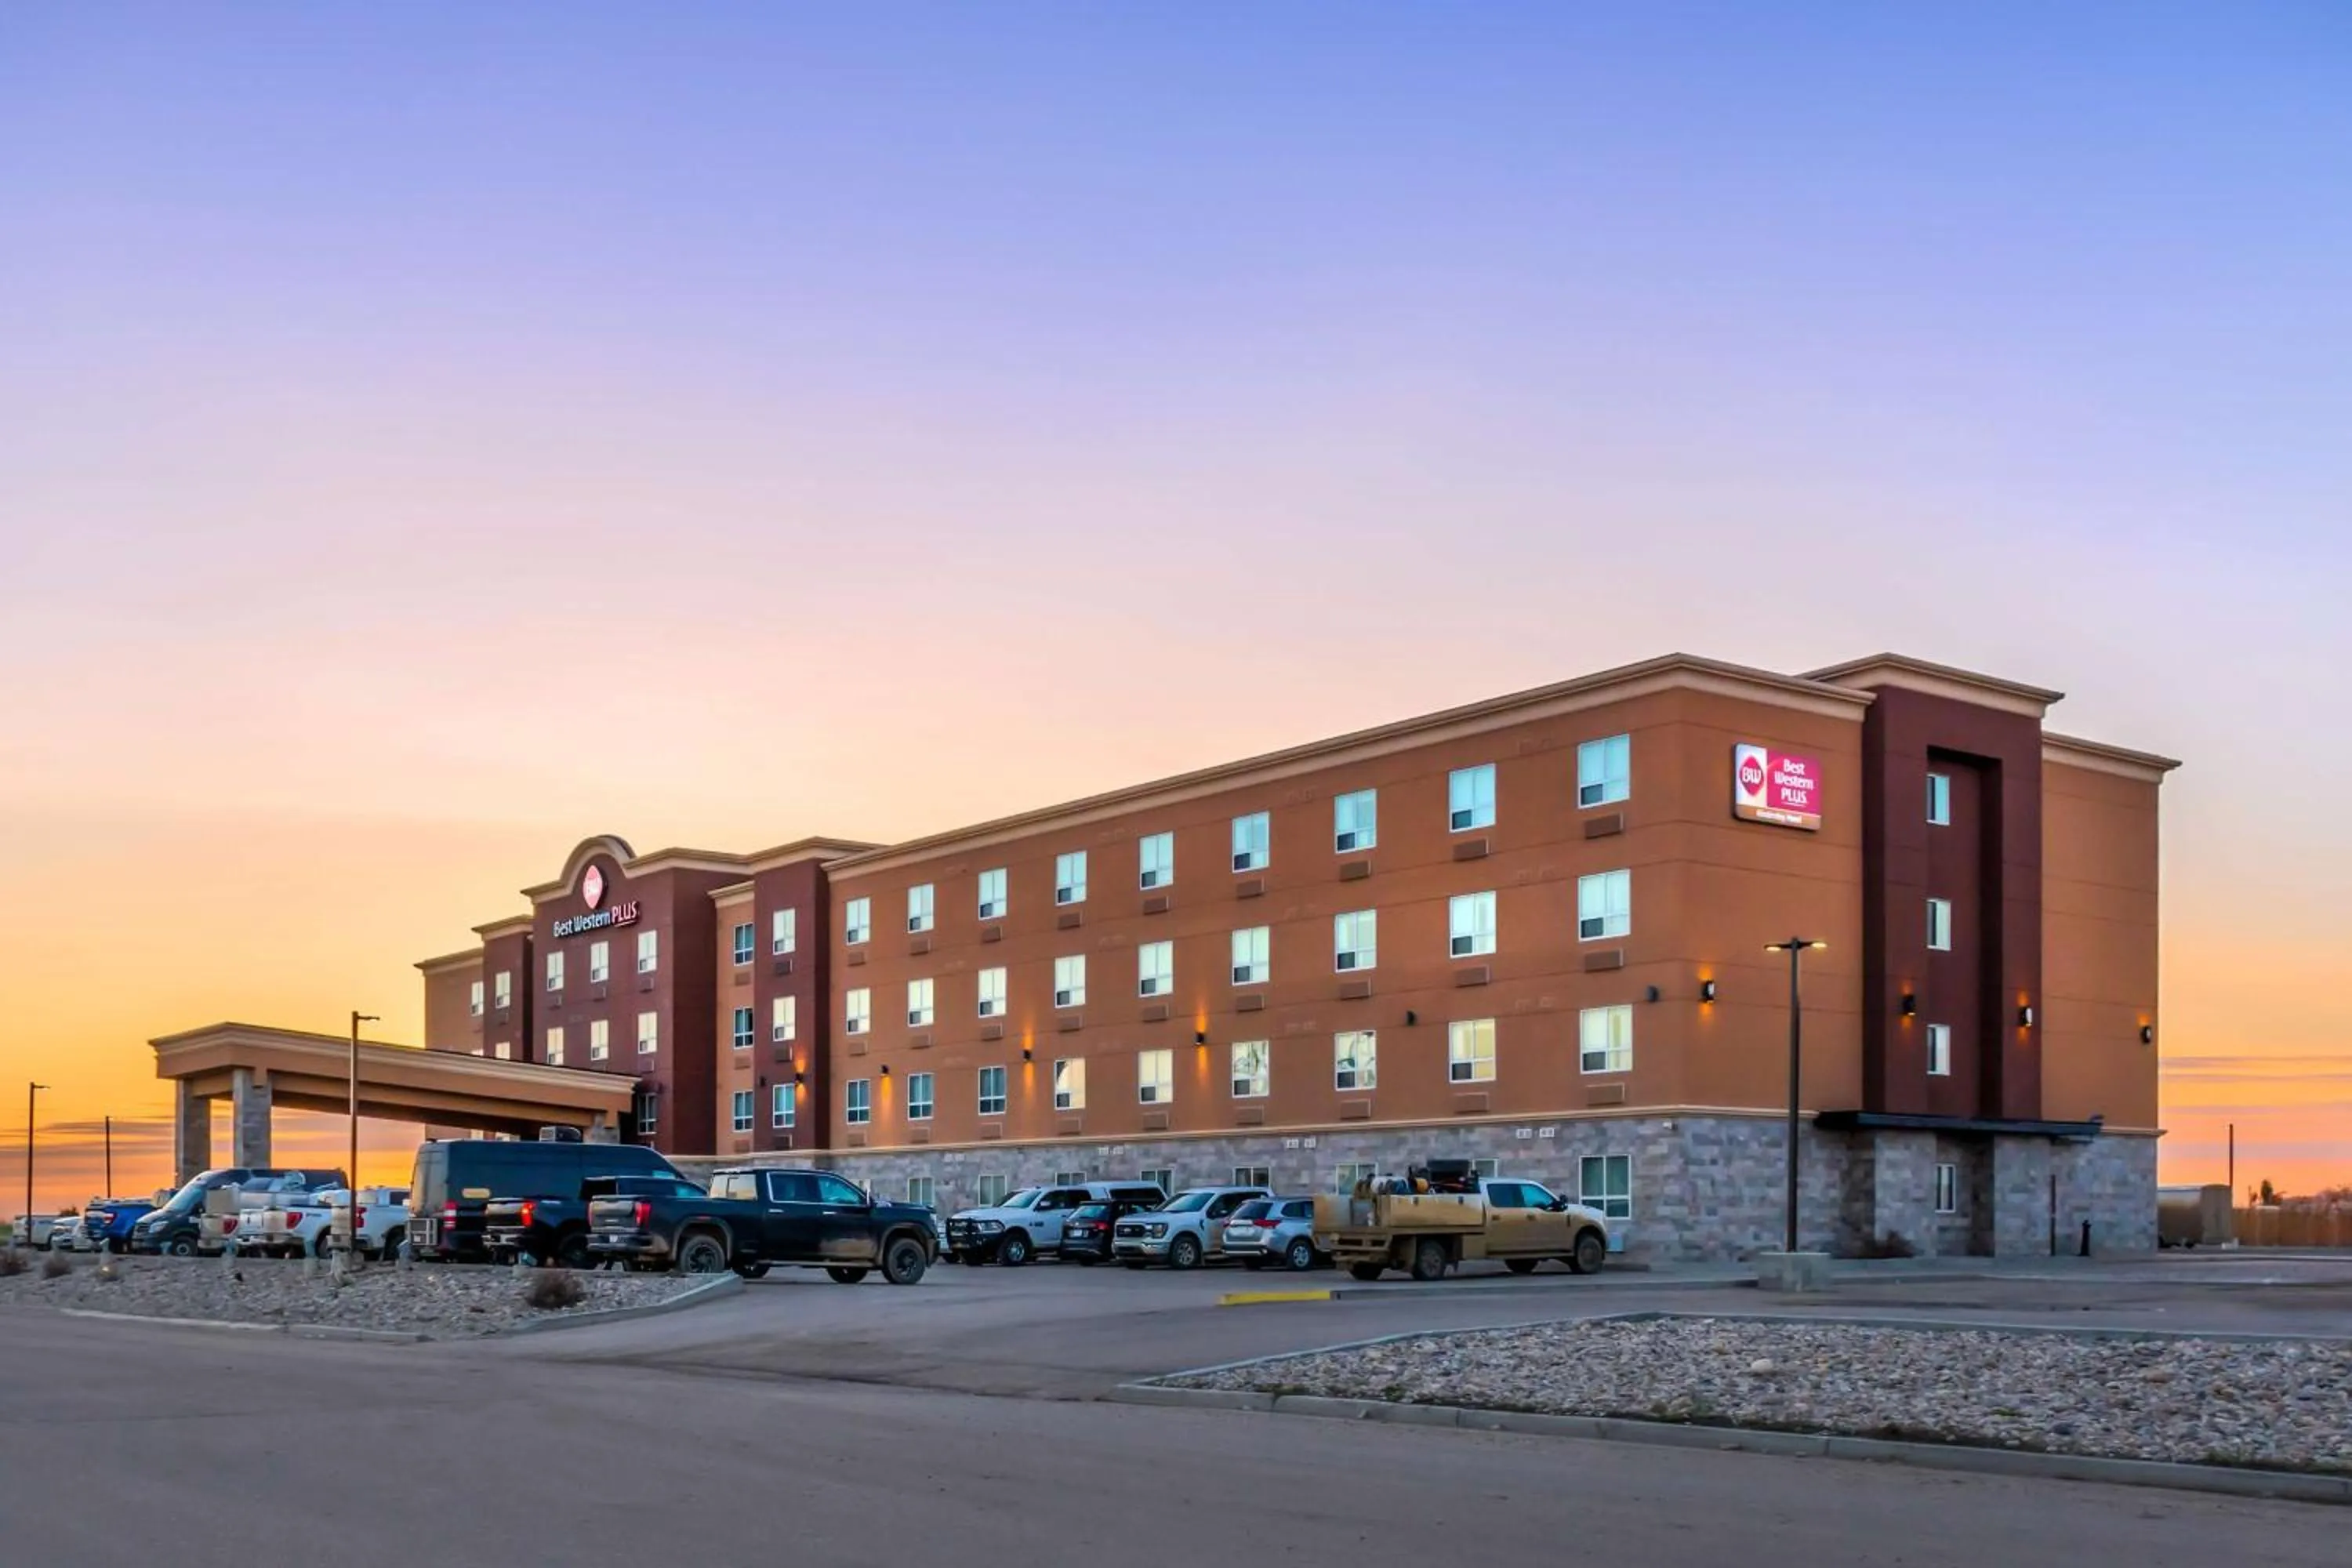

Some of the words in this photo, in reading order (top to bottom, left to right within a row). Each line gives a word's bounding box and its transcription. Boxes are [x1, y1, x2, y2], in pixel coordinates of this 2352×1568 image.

[1784, 758, 1805, 775] Best
[1742, 767, 1762, 784] BW
[1774, 771, 1813, 790] Western
[1781, 787, 1807, 804] PLUS
[554, 919, 573, 937] Best
[573, 911, 611, 933] Western
[612, 900, 637, 924] PLUS
